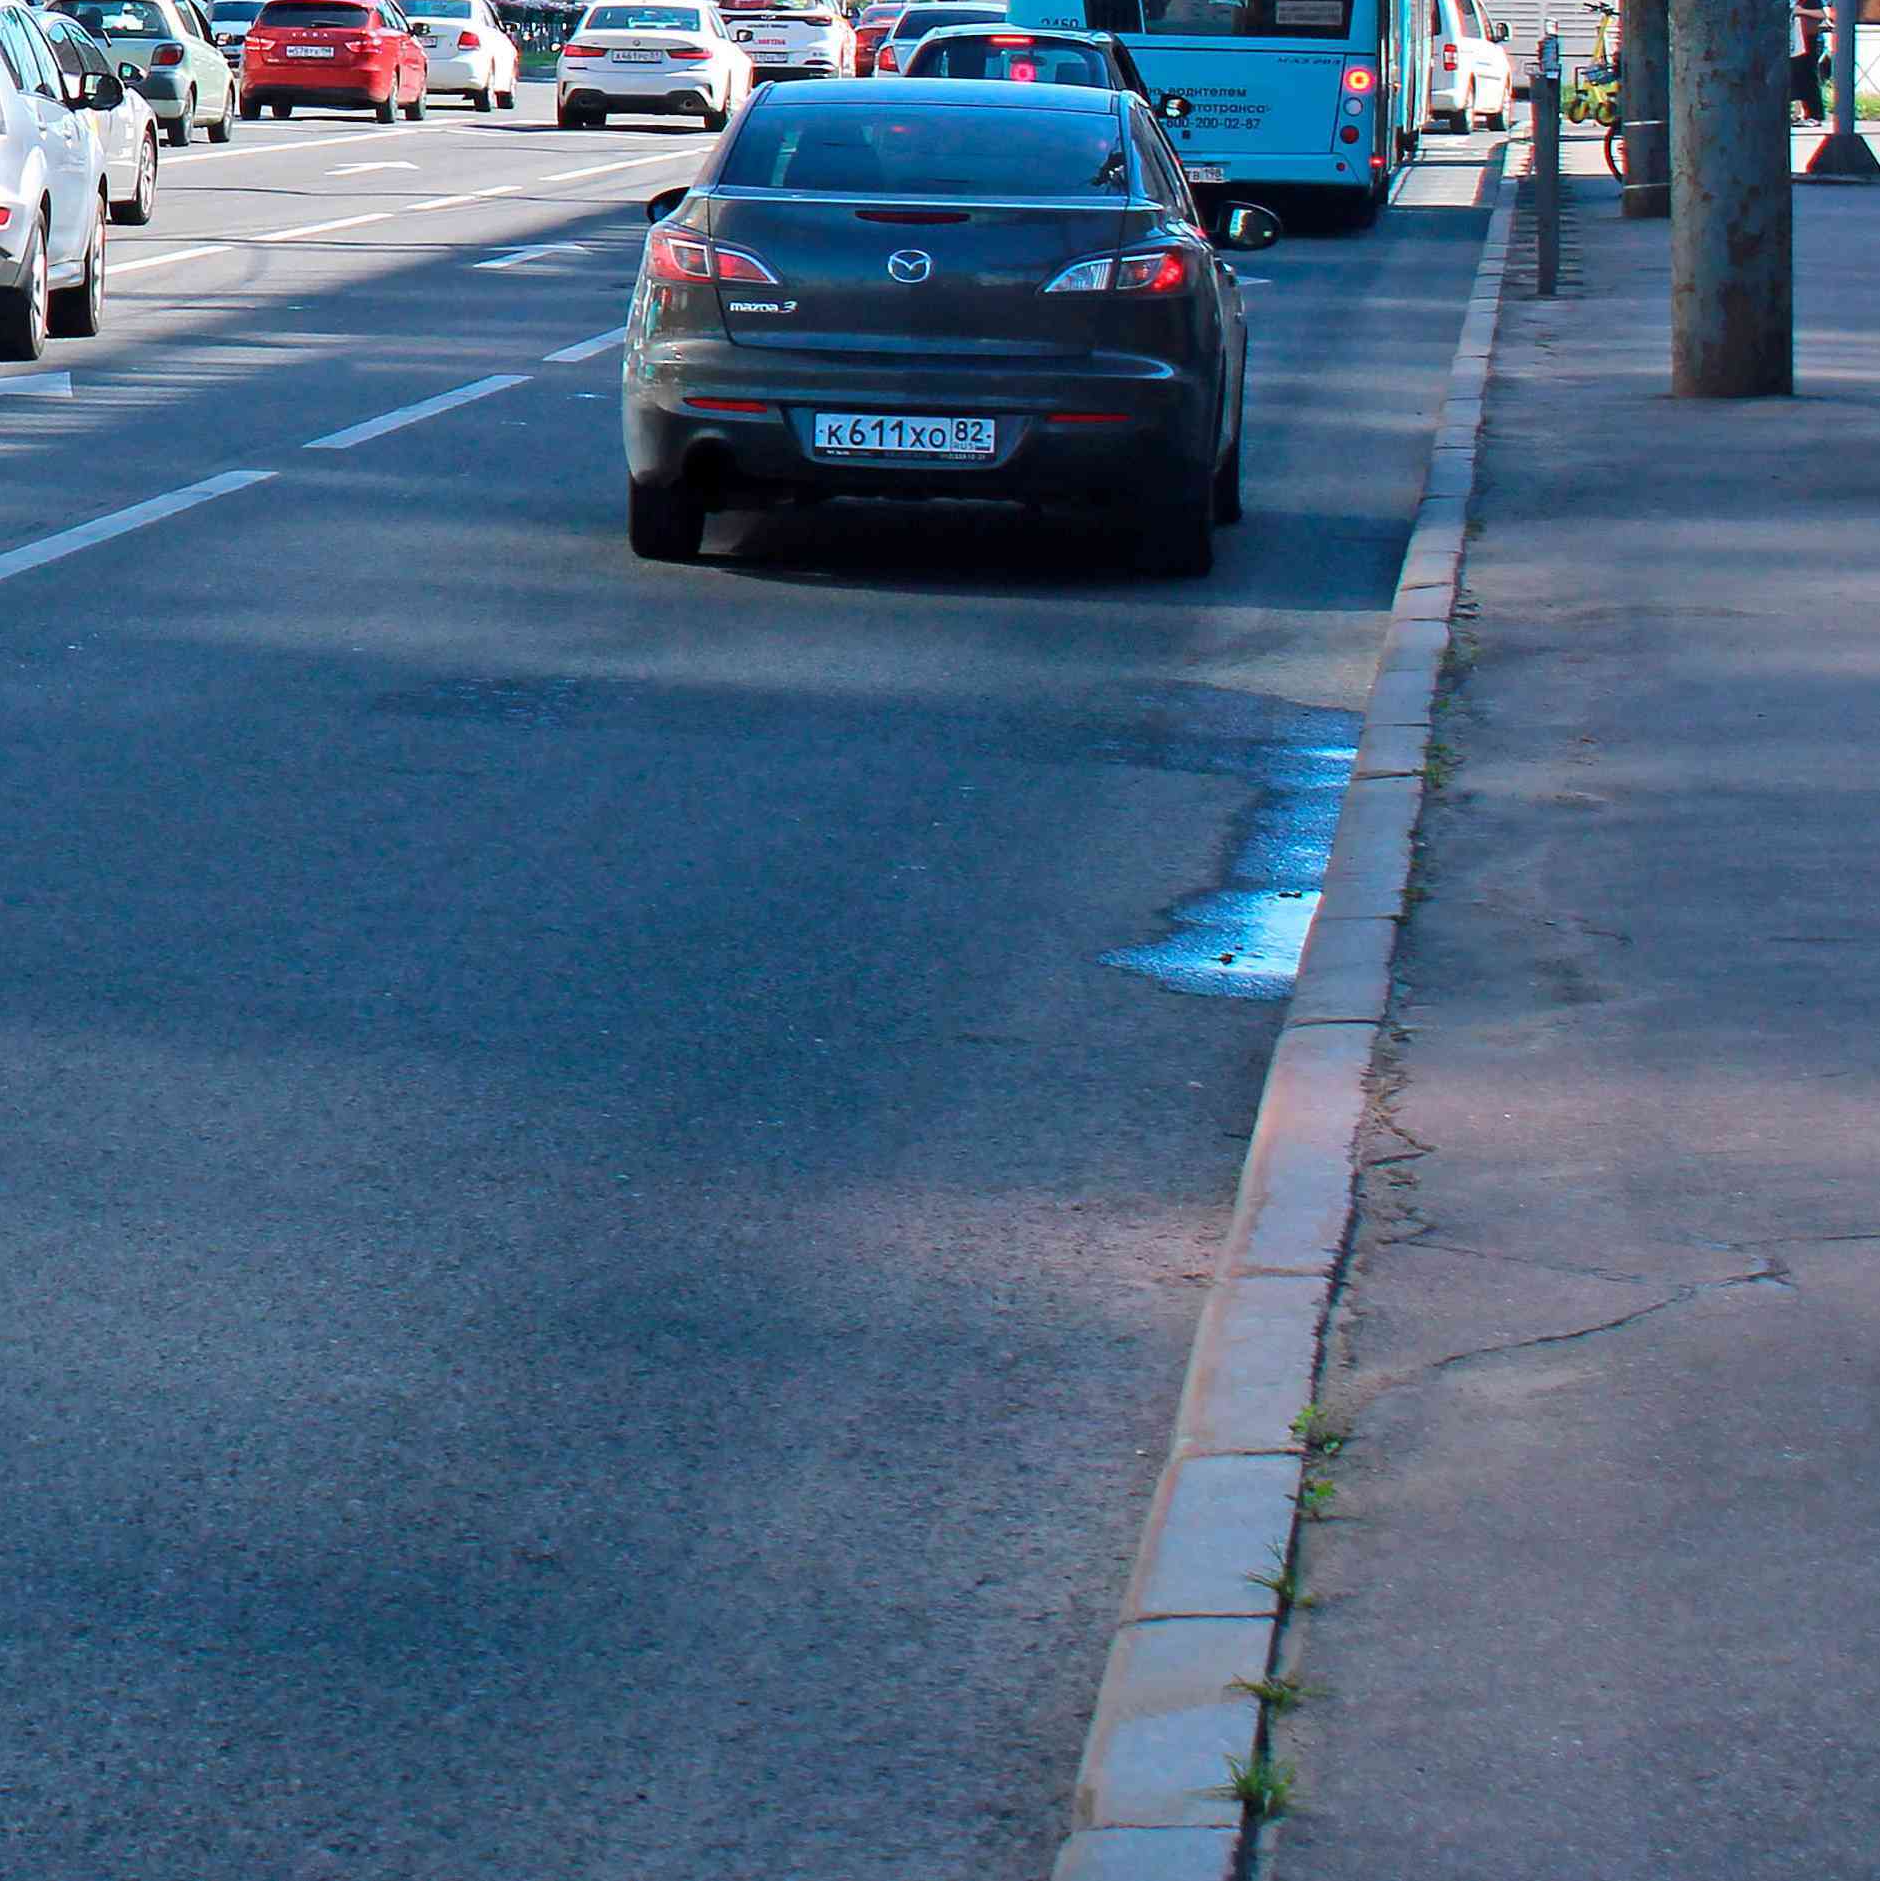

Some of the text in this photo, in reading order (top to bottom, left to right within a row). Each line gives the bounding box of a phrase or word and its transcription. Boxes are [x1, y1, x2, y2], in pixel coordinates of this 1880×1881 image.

[1157, 118, 1262, 129] -800-200-02-87
[826, 418, 984, 448] К611ХО 82
